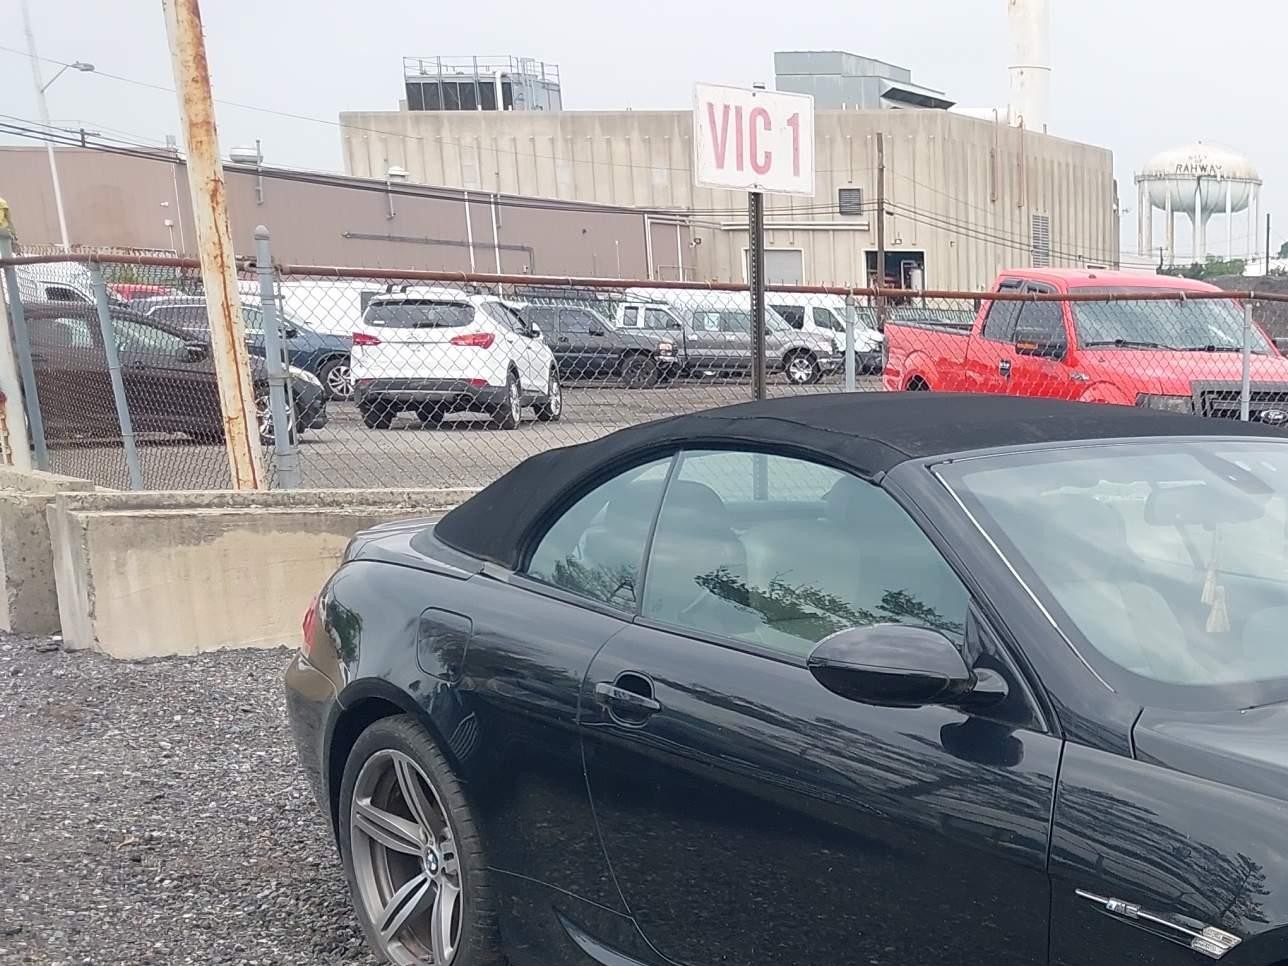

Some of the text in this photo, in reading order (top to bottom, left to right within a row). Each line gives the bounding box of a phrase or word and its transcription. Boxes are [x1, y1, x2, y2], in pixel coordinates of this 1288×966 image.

[707, 102, 800, 177] VIC 1
[1175, 163, 1222, 174] RAHWAY
